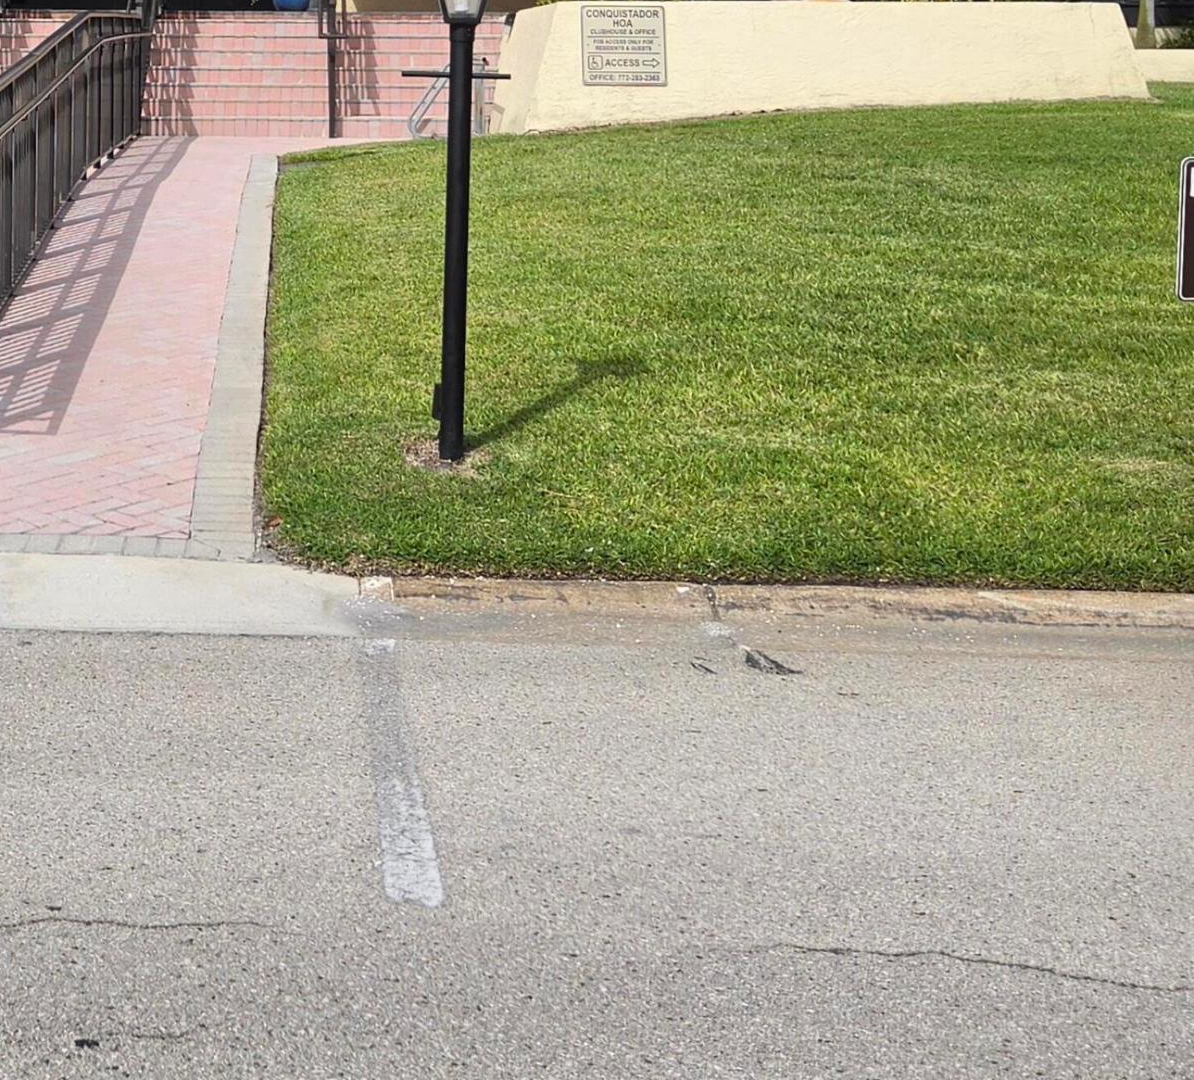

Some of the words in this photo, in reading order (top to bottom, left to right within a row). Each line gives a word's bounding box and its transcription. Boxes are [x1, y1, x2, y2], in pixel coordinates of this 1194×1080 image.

[586, 9, 659, 18] CONQUISTADOR
[613, 19, 633, 27] HOA
[605, 59, 640, 67] ACCESS
